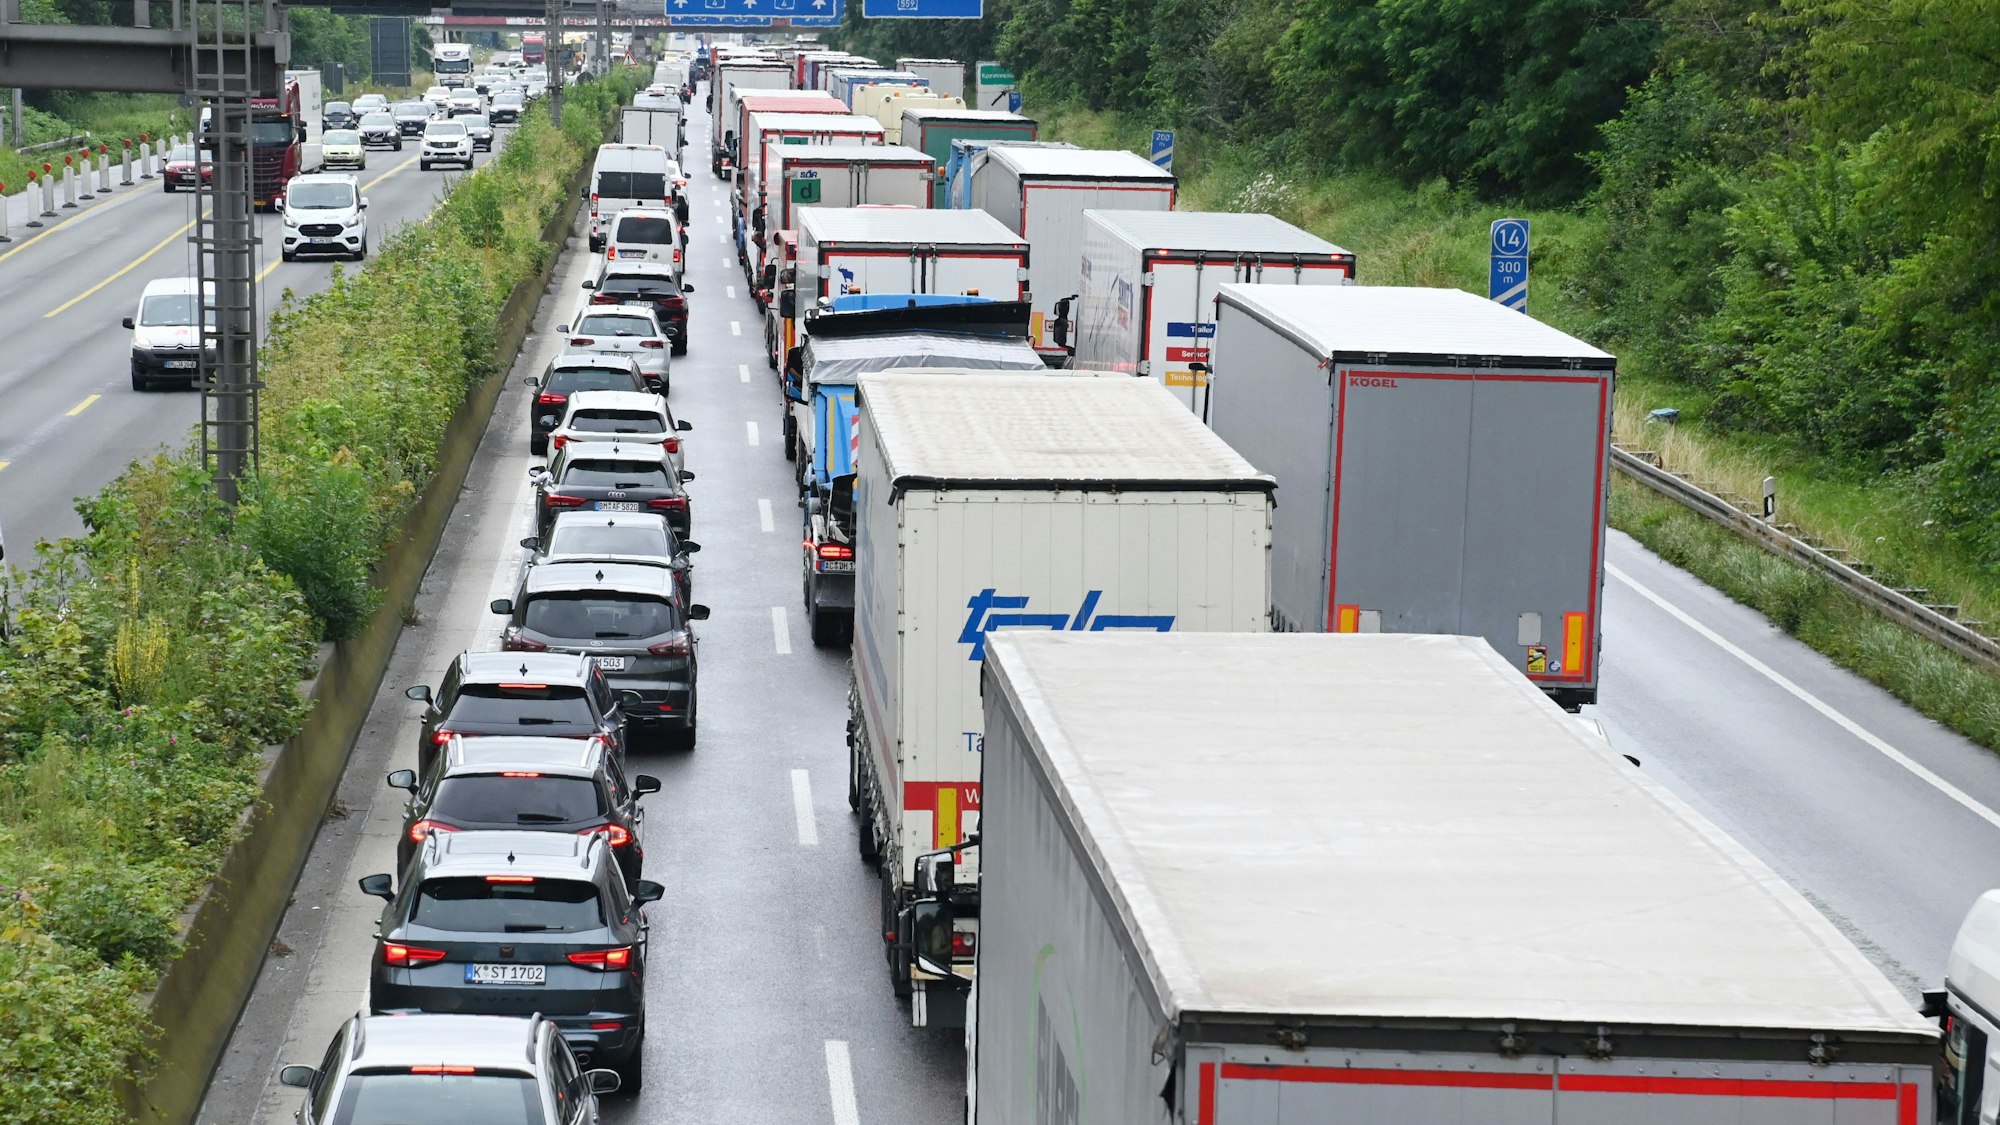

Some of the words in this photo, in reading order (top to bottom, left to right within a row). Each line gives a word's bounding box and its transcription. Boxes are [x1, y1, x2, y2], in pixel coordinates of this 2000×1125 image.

[1156, 133, 1170, 142] 200
[800, 183, 812, 199] d
[1500, 229, 1520, 247] 14
[1498, 261, 1521, 273] 300
[1190, 325, 1214, 333] Tailer
[603, 658, 621, 667] 503
[474, 966, 481, 978] K
[491, 966, 507, 979] ST
[511, 967, 543, 980] 1702
